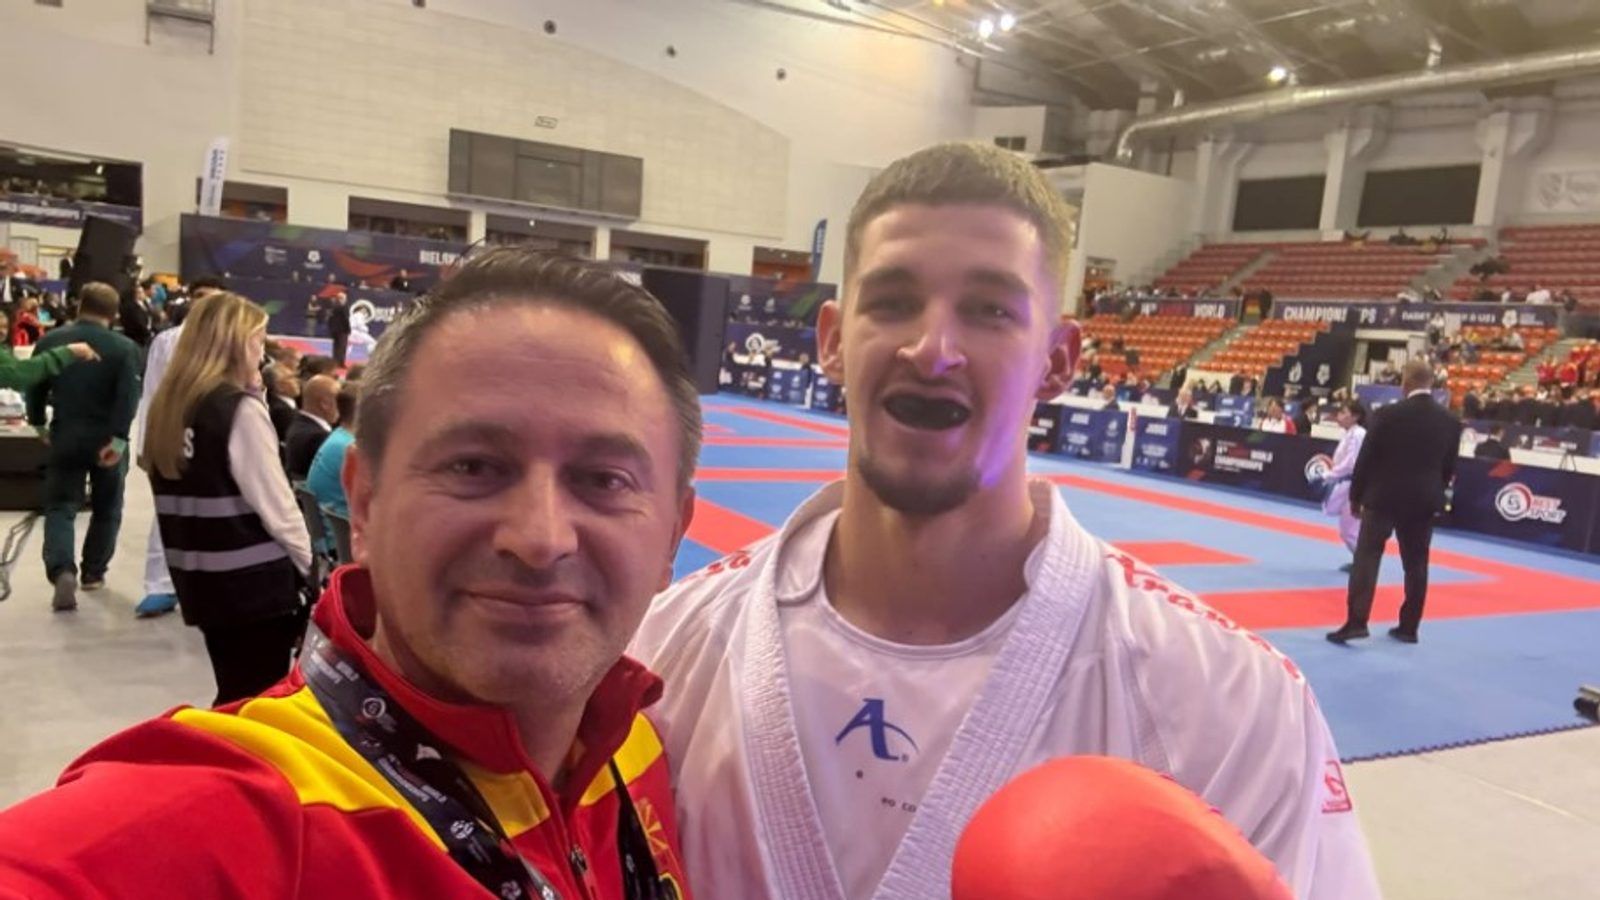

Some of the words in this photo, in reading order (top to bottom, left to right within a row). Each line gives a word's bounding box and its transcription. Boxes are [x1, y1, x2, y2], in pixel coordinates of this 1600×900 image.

[1194, 304, 1226, 319] WORLD
[1531, 495, 1562, 511] BEST
[1524, 507, 1567, 525] SPORT
